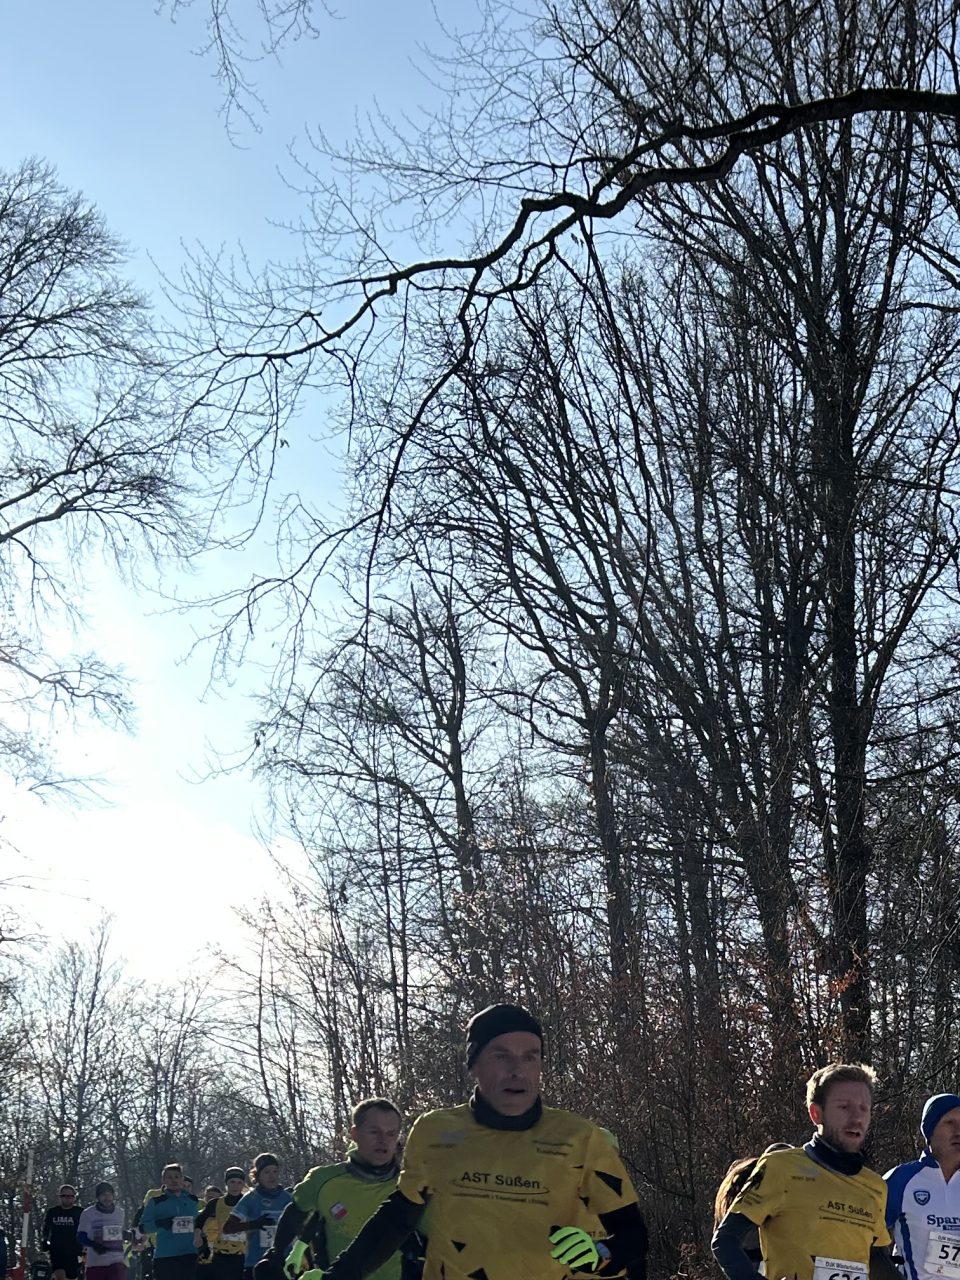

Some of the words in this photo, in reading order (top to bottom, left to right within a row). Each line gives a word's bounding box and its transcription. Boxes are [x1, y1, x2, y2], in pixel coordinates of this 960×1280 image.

[461, 1171, 490, 1183] AST
[495, 1174, 540, 1189] Süßen
[827, 1200, 845, 1211] AST
[848, 1205, 873, 1219] Süßen
